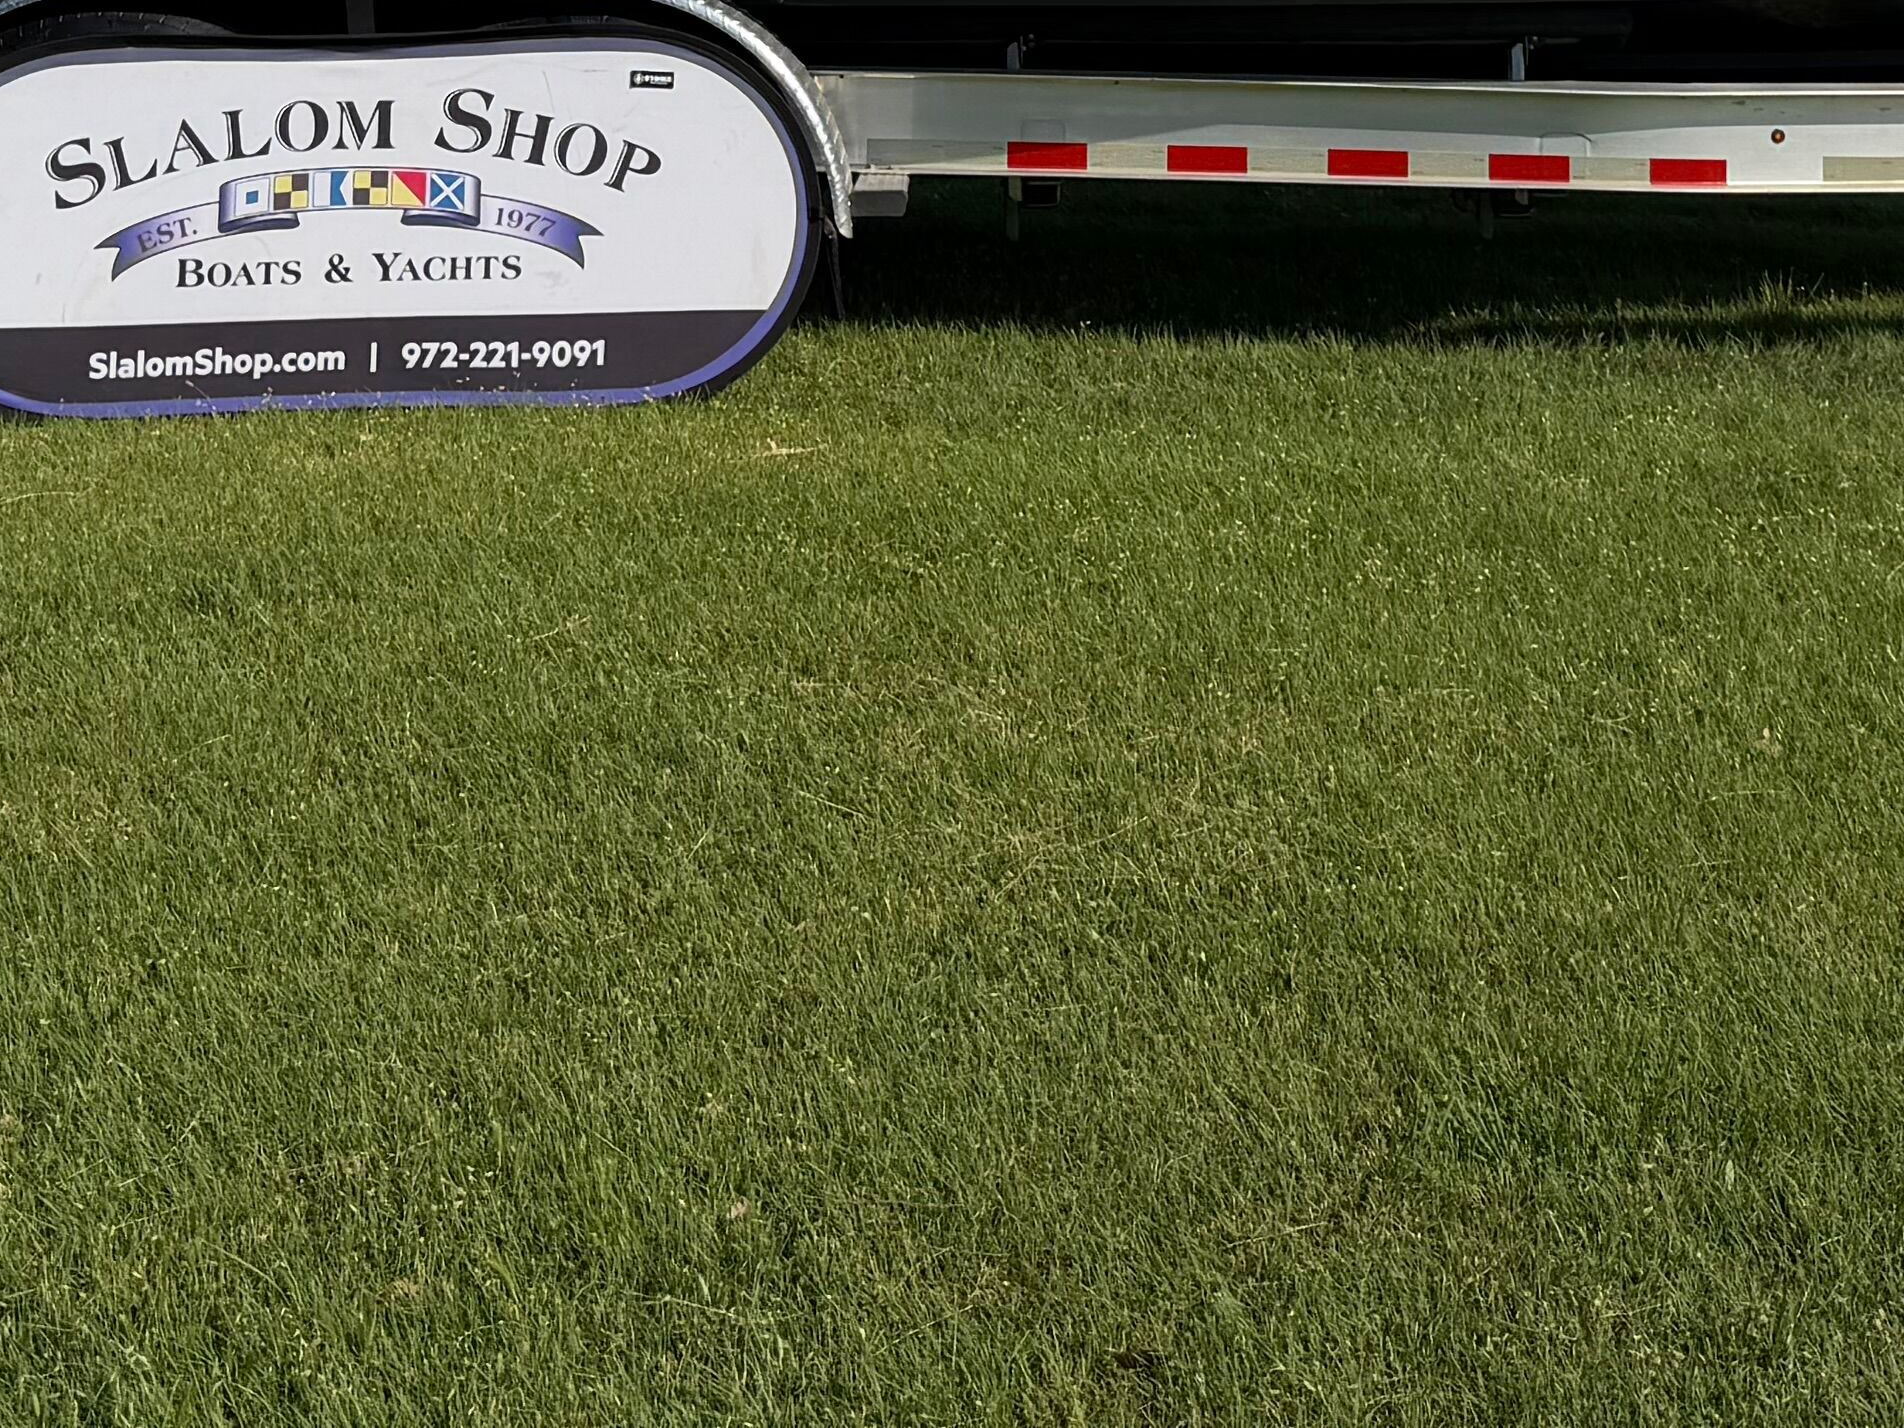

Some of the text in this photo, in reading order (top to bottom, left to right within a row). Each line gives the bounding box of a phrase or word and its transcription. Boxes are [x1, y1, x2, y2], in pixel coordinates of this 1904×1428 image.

[45, 87, 662, 209] SLALOM SHOP
[136, 216, 198, 252] EST.
[494, 206, 557, 238] 1977
[176, 253, 523, 288] BOATS & YACHTS
[88, 340, 607, 379] SlalomShop.com 972-221-9091
